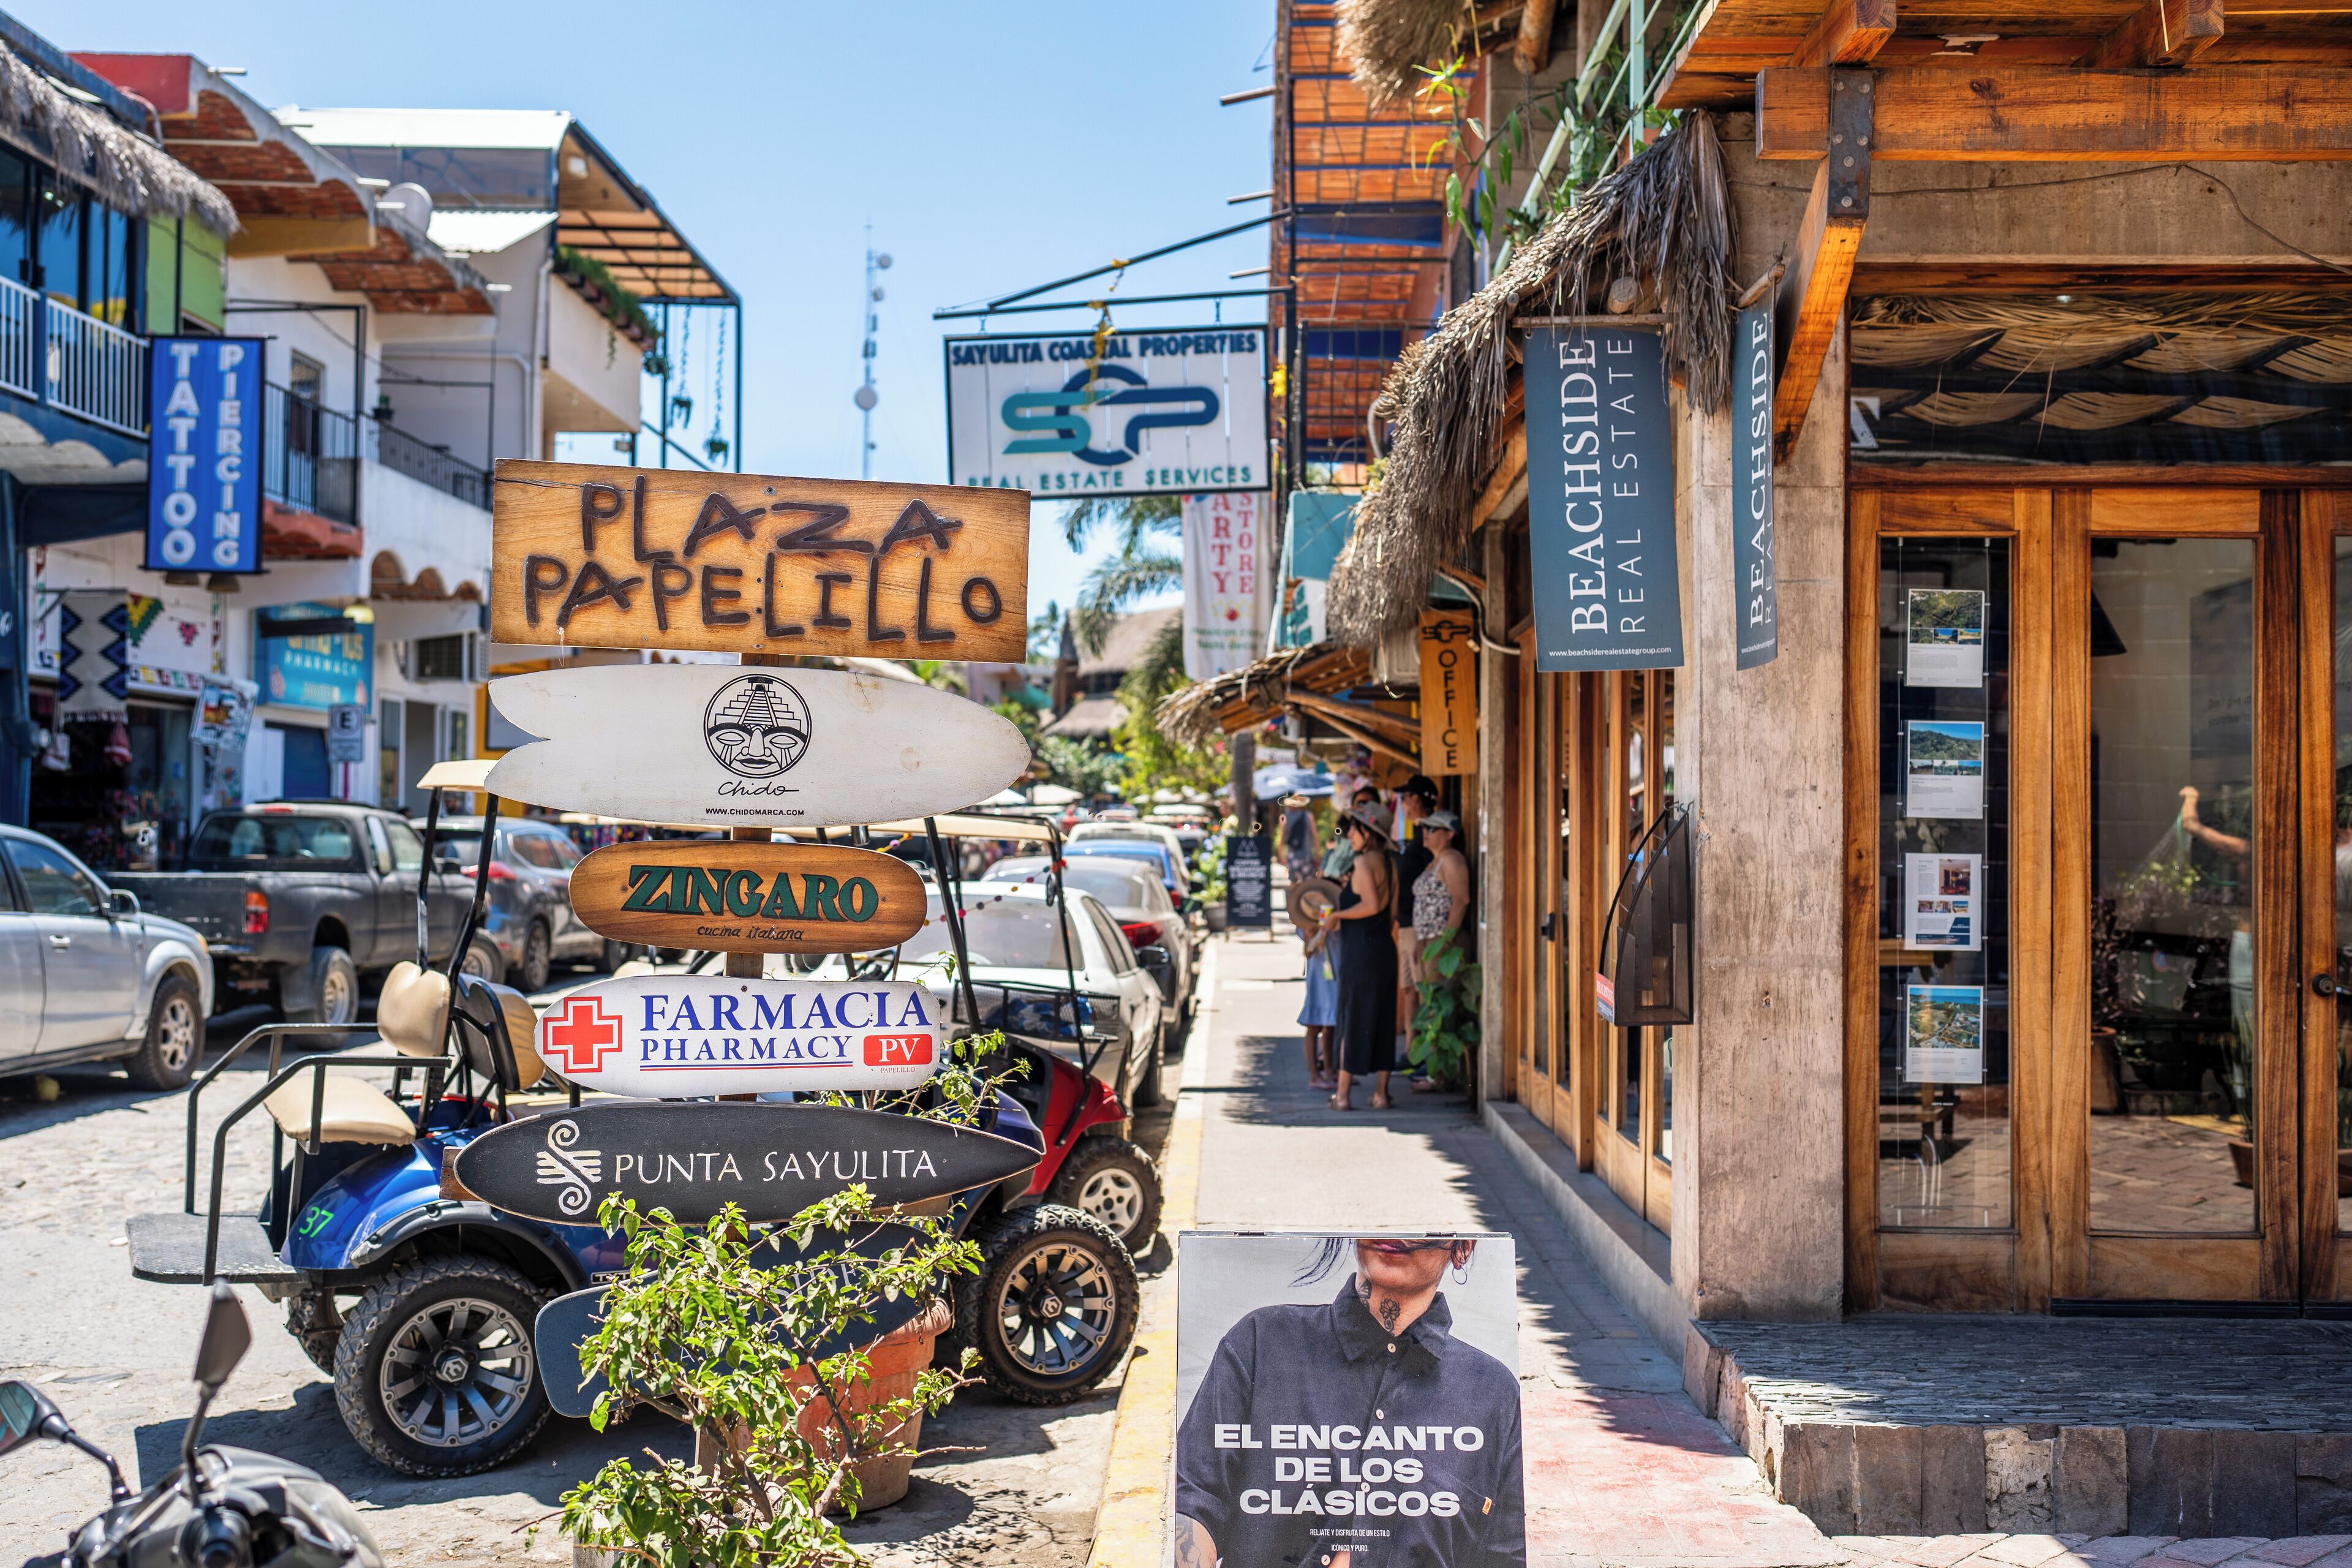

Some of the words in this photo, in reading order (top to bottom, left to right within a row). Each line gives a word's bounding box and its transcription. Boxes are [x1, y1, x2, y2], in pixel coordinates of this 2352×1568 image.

[952, 343, 1042, 366] SAYULITA
[1048, 339, 1132, 362] COASAL
[1140, 333, 1257, 358] PROPERTIES
[1607, 339, 1639, 497] ESTATE
[162, 342, 201, 565] TATTOO
[212, 343, 245, 567] PIERCING
[1750, 312, 1768, 630] BEACHSIDE
[1041, 470, 1123, 490] ESTATE
[1145, 466, 1252, 486] SERVICES
[1559, 339, 1608, 635] BEACHSIDE
[581, 474, 963, 562] PLAZA
[1211, 494, 1232, 594] ARTY
[1237, 492, 1254, 594] STORE
[522, 552, 1002, 643] PAPELILLO
[1616, 528, 1646, 633] REAL
[1549, 646, 1672, 657] www.beachsiderealestategroup.com
[340, 710, 353, 729] E
[1438, 649, 1458, 768] OFFICE
[718, 779, 801, 798] Chido
[705, 807, 805, 816] WWW.CHIDOMARCA.COM
[621, 864, 880, 923] ZINGARO
[697, 925, 741, 938] cucina
[744, 925, 805, 941] italiana
[639, 991, 932, 1033] FARMACIA
[639, 1035, 853, 1061] PHARMACY
[878, 1038, 921, 1063] PV
[615, 1151, 743, 1185] PUNTA
[763, 1148, 938, 1182] SAYULITA
[298, 1206, 334, 1238] 37
[1215, 1423, 1262, 1449] EL
[1271, 1425, 1484, 1452] ENCANTO
[1275, 1457, 1331, 1482] DE
[1340, 1458, 1424, 1483] LOS
[1240, 1483, 1460, 1517] CLÁSICOS
